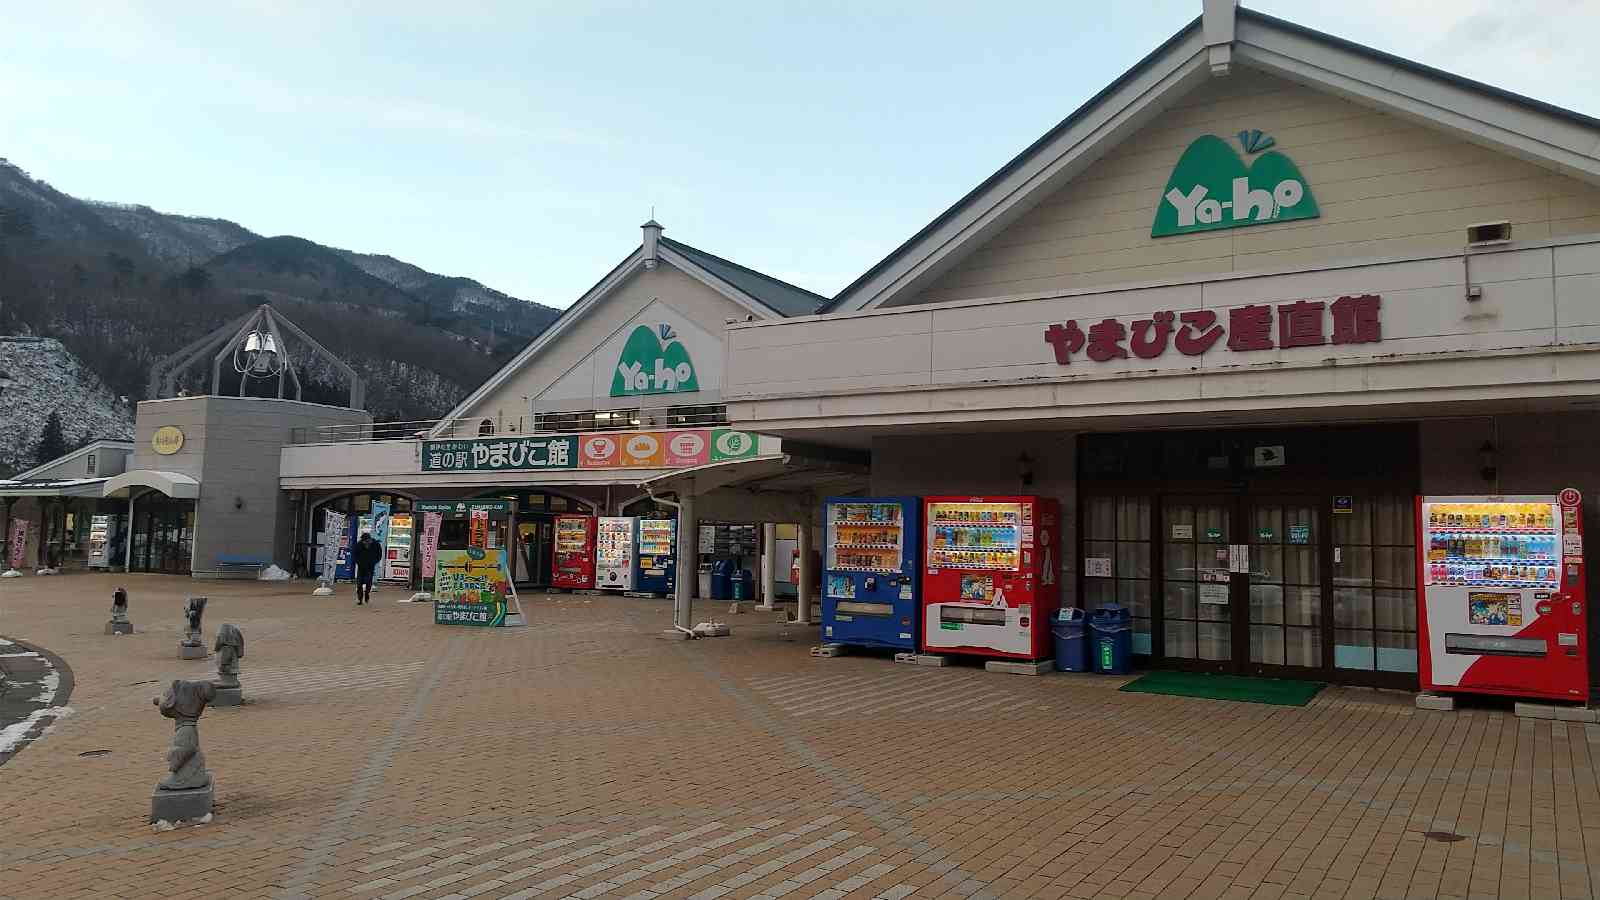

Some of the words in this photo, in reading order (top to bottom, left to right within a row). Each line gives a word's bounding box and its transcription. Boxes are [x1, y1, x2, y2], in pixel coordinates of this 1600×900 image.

[1165, 177, 1304, 227] Ya-ho
[1044, 294, 1382, 366] やまびこ産直館
[618, 358, 692, 392] Ya-ho
[429, 452, 469, 469] 道の駅
[471, 440, 570, 469] やまびこ館
